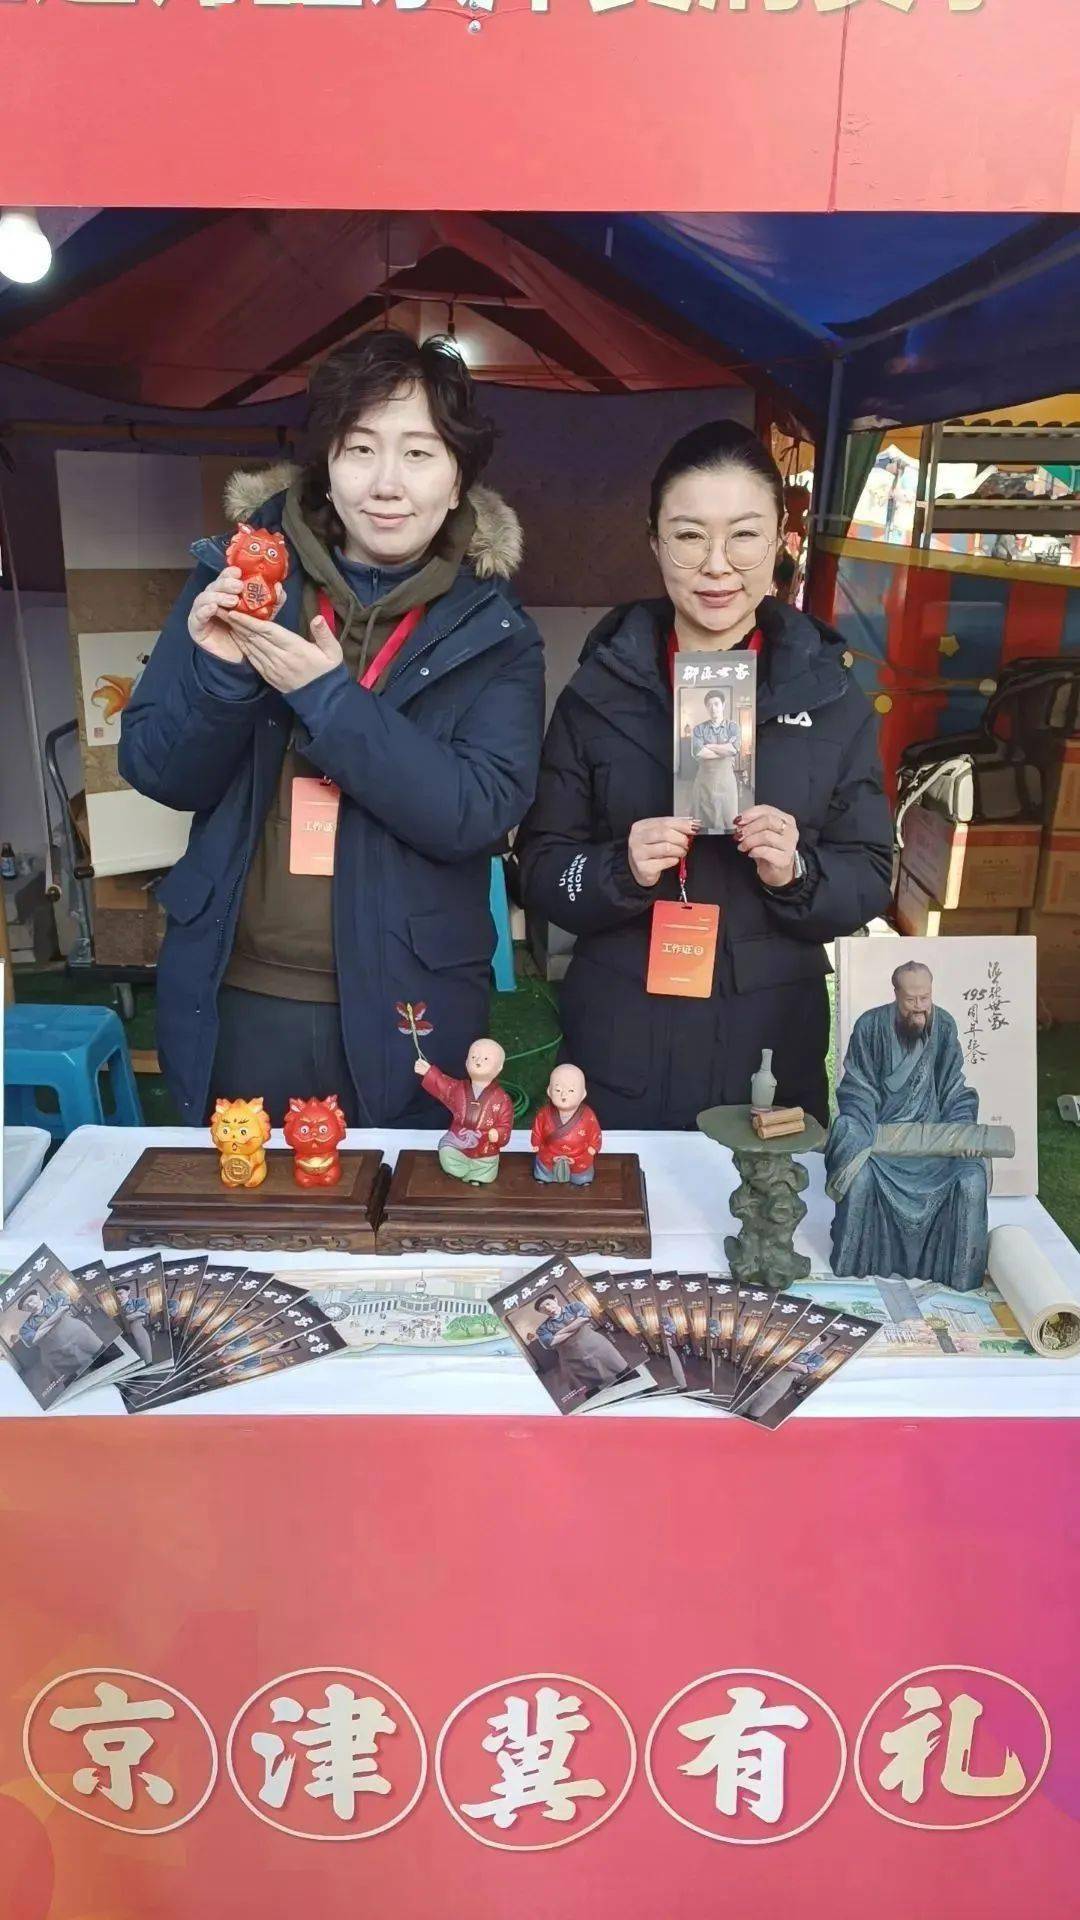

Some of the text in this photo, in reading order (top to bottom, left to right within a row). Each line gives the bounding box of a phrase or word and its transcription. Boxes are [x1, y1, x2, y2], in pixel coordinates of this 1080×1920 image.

[776, 711, 813, 727] ILA
[49, 1681, 1027, 1829] 京津冀有礼
